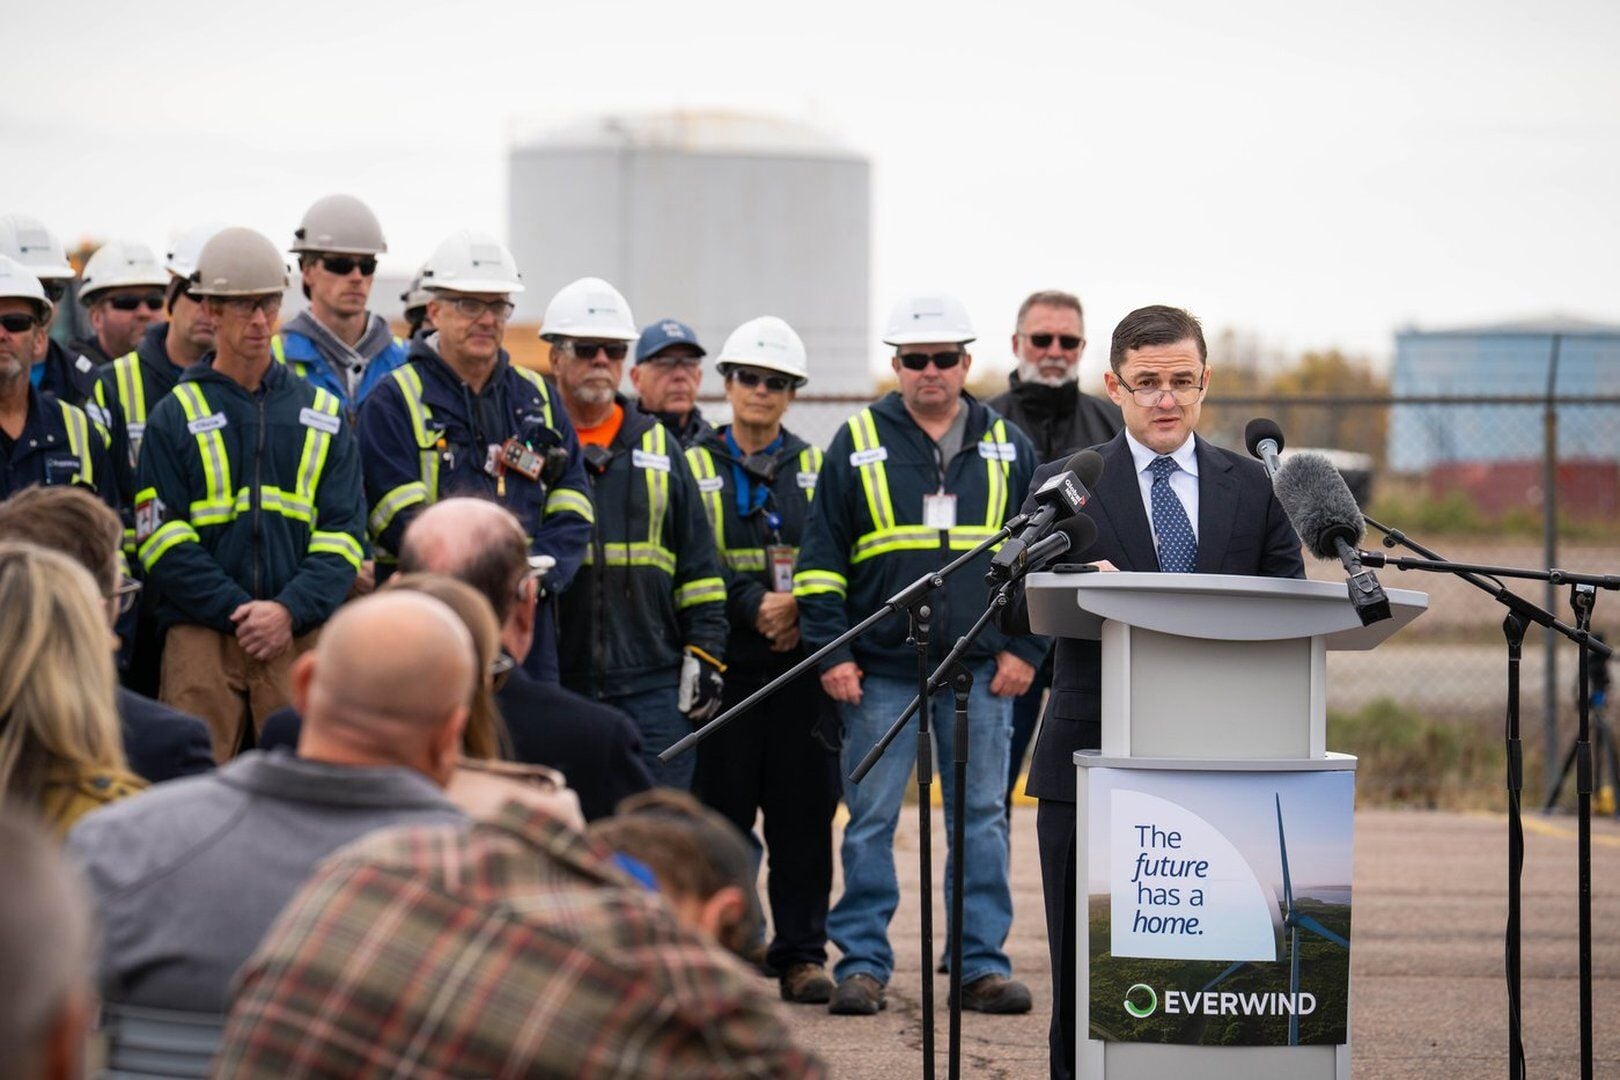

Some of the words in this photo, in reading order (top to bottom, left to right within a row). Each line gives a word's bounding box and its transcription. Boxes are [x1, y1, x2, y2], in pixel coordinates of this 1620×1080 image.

[1065, 479, 1082, 502] Global
[1135, 825, 1181, 849] The
[1131, 853, 1208, 882] future
[1137, 882, 1180, 906] has
[1190, 889, 1203, 906] a
[1132, 910, 1203, 935] home.
[1164, 990, 1316, 1016] EVERWIND
